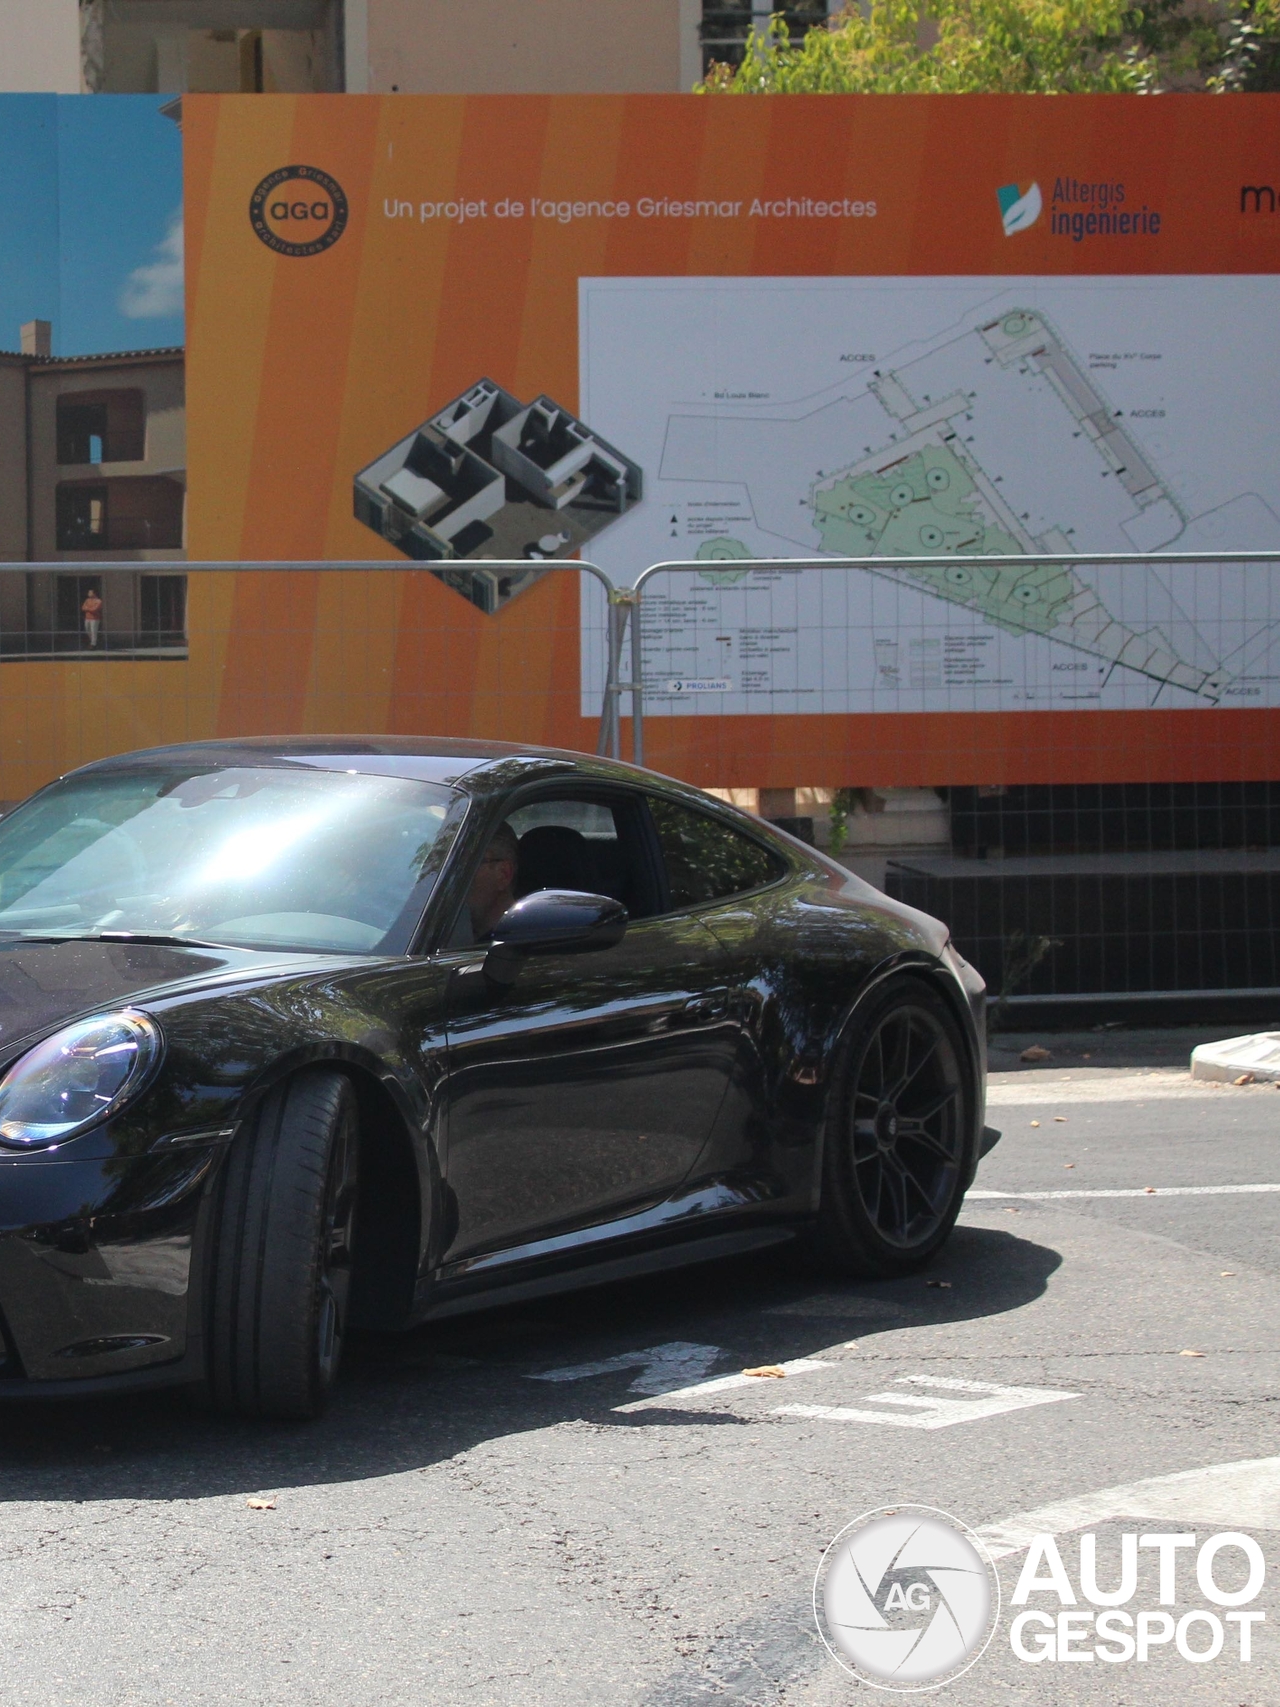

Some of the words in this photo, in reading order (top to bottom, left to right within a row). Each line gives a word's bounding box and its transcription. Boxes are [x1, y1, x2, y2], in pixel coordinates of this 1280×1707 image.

[1052, 177, 1126, 209] Altergis
[383, 198, 413, 218] Un
[421, 197, 487, 224] projet
[494, 197, 524, 218] de
[531, 197, 630, 224] l'agence
[636, 197, 742, 218] Griesmar
[749, 197, 877, 218] Architectes
[1051, 204, 1161, 242] ingénierie
[839, 353, 876, 363] ACCES
[1130, 409, 1167, 417] ACCES
[1052, 663, 1088, 671] ACCES
[686, 682, 727, 690] PROLIANS
[1225, 687, 1261, 695] ACCES
